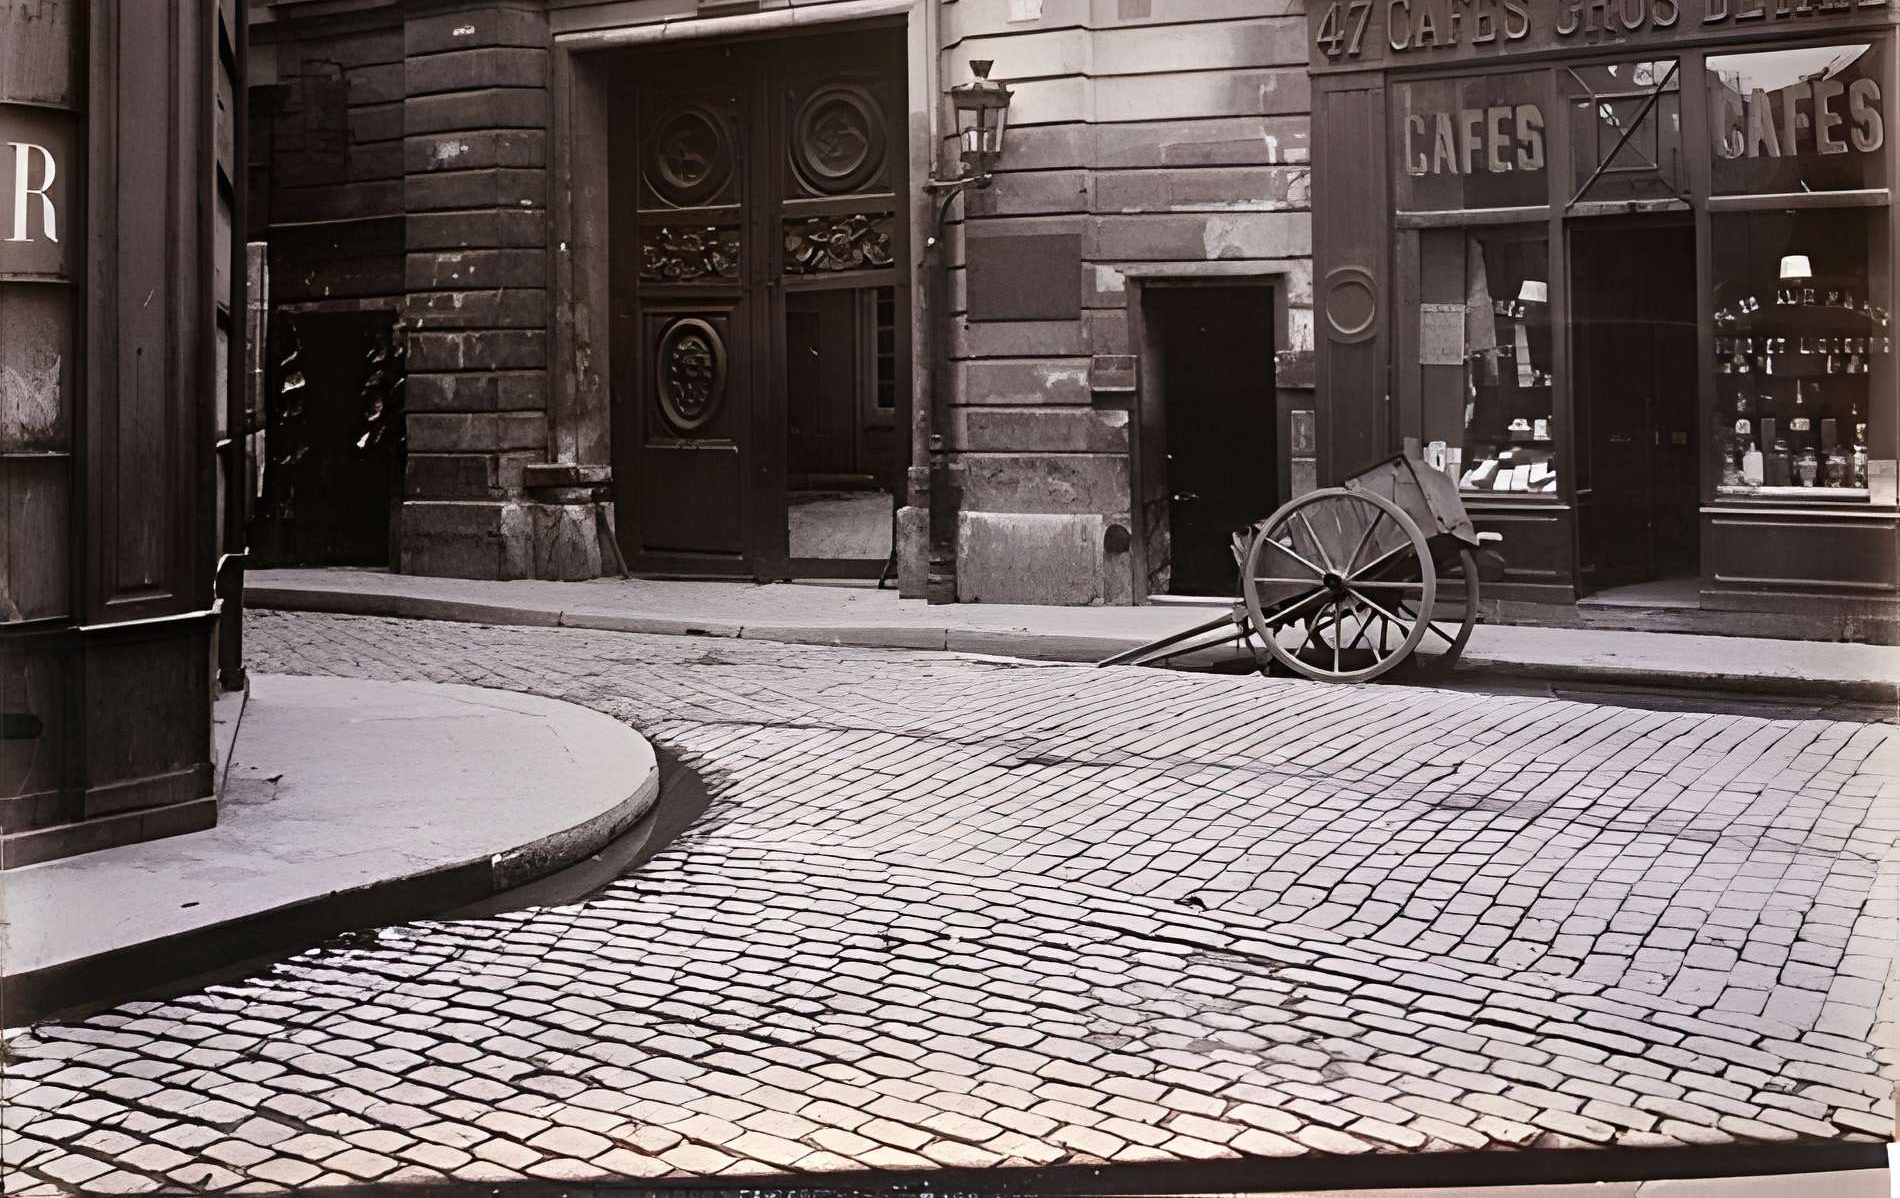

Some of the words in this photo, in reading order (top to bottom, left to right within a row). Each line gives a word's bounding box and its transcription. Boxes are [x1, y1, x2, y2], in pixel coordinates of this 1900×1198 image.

[1316, 1, 1373, 57] 47
[1710, 78, 1884, 159] CAFES
[4, 142, 58, 242] R
